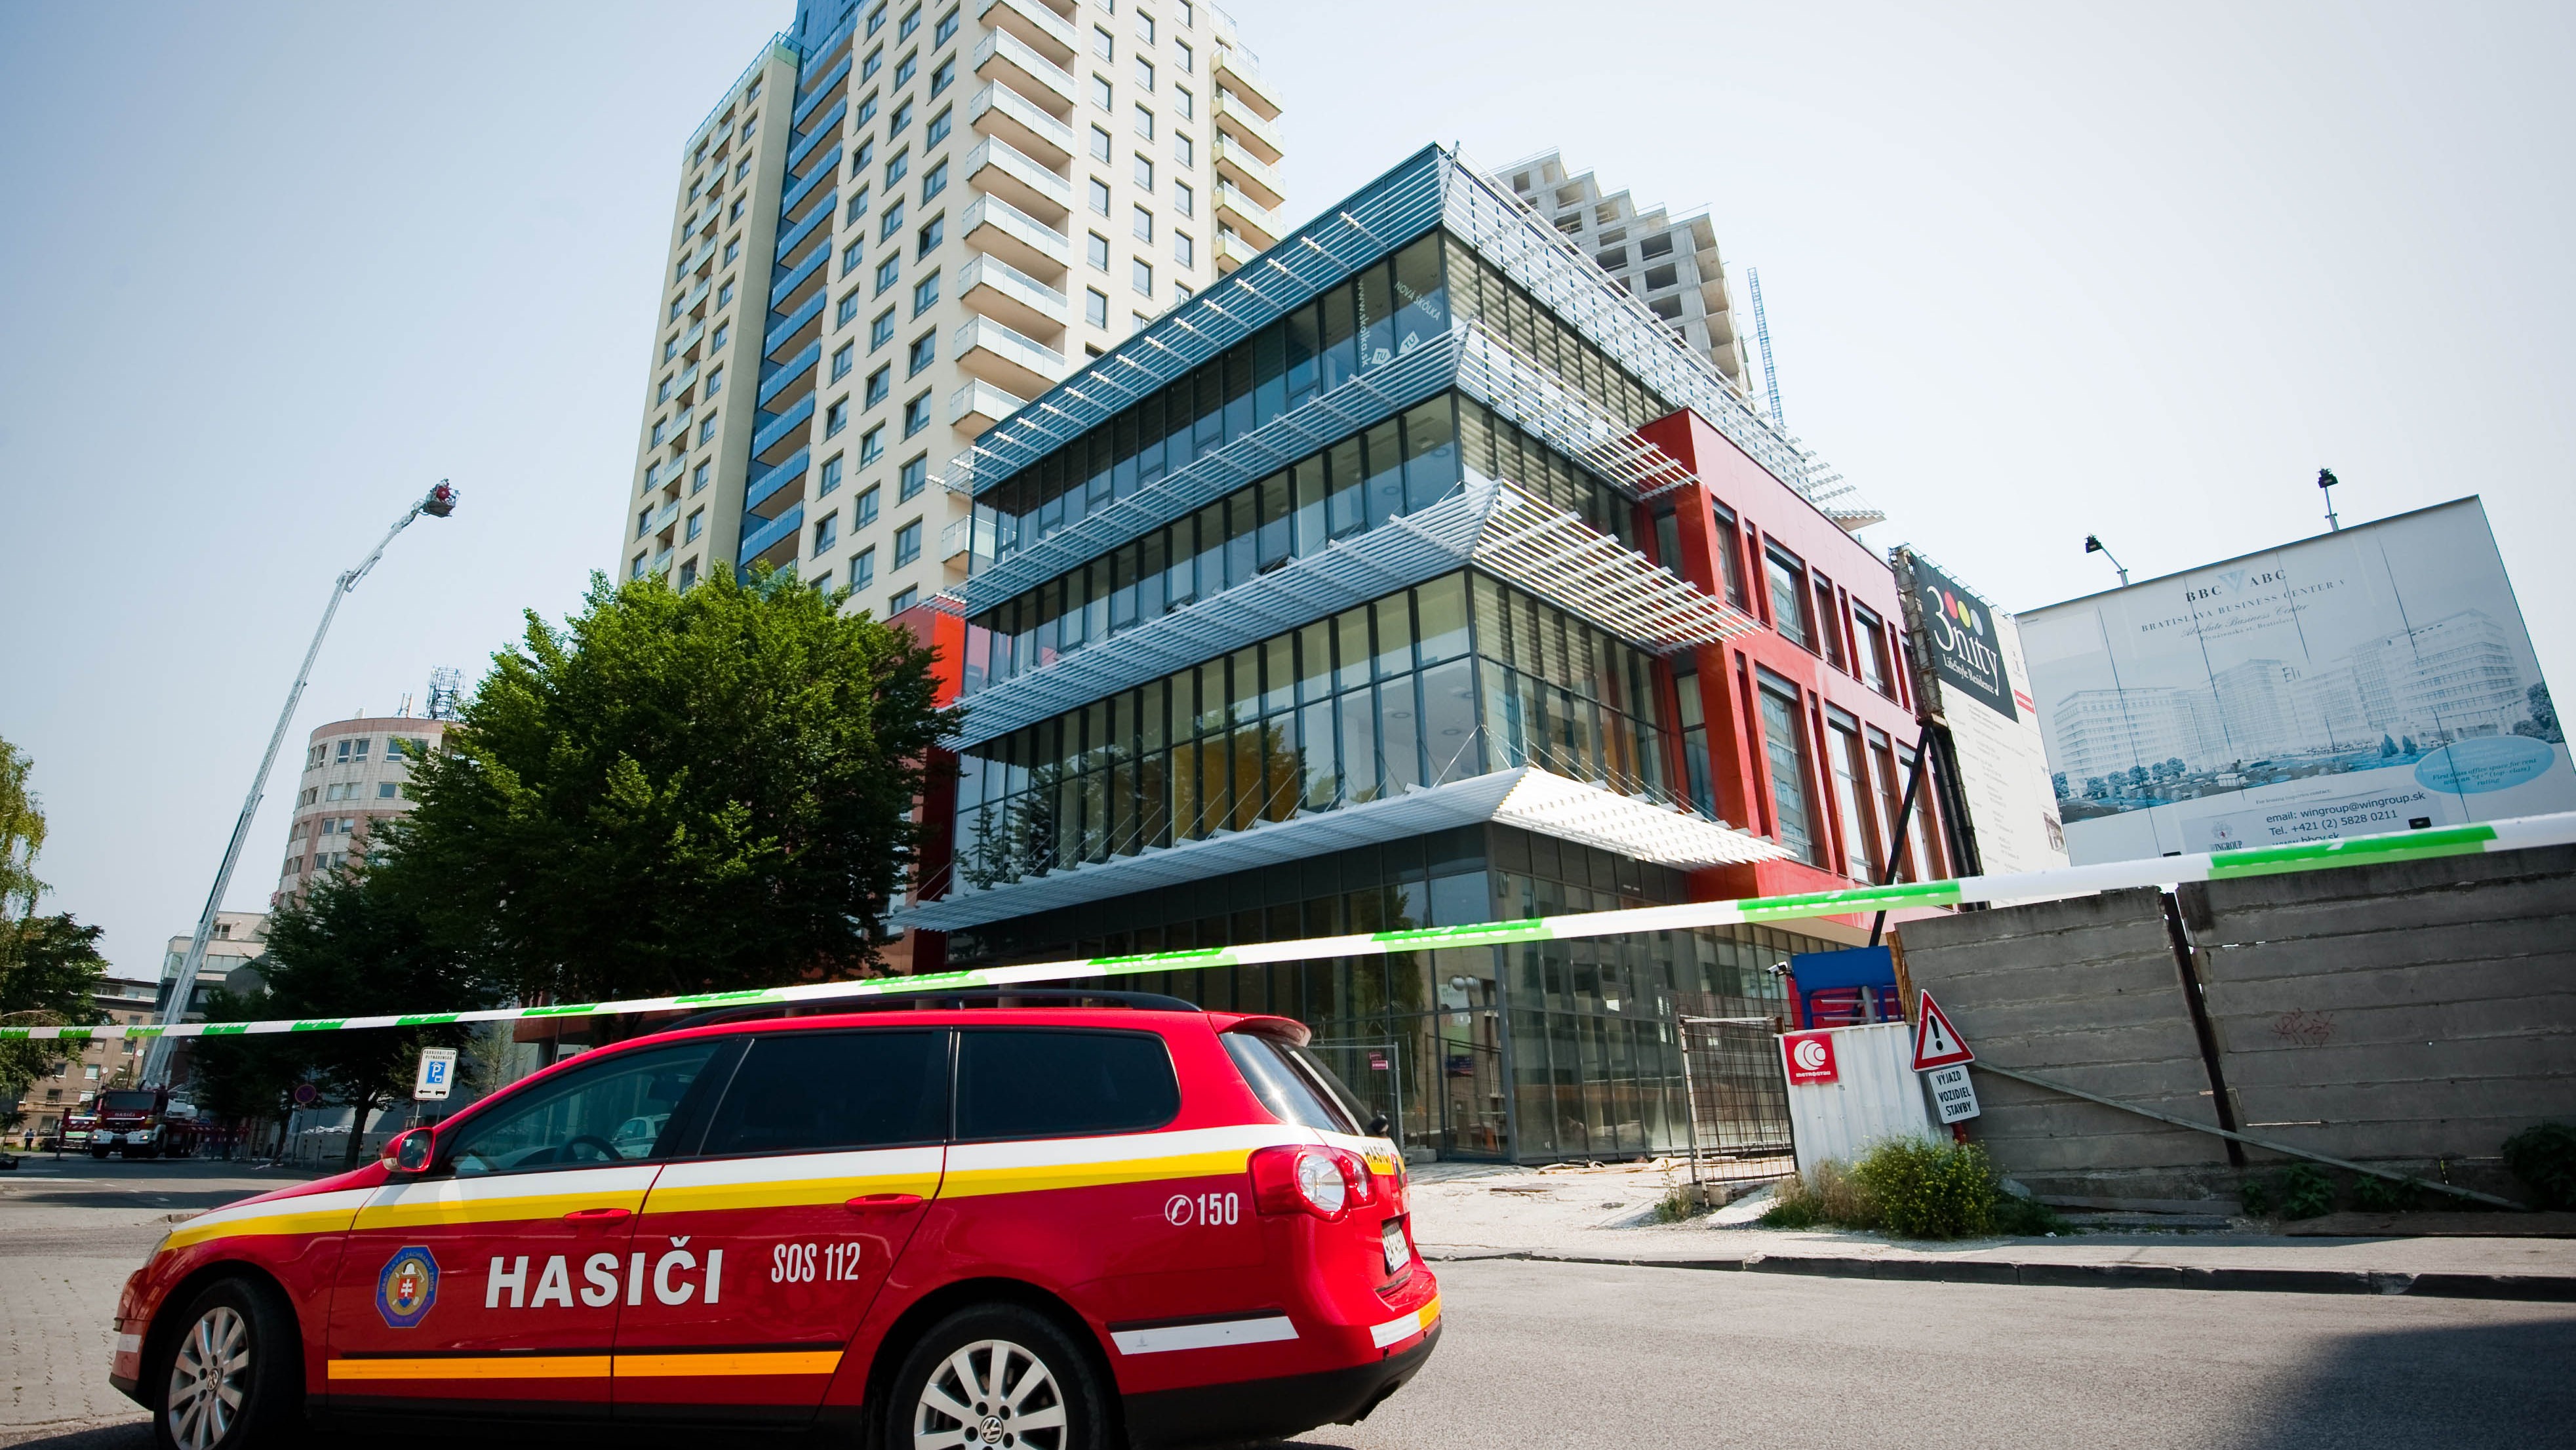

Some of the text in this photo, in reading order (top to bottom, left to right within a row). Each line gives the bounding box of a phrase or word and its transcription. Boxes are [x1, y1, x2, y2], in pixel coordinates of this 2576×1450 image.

[1395, 281, 1440, 321] NOVÁ ŠKÔLKA
[1358, 279, 1372, 367] www.skolka.sk
[2185, 569, 2287, 602] BBC ABC
[2141, 610, 2213, 632] BRATISLAVA
[2218, 595, 2277, 614] BUSINESS
[2284, 581, 2333, 598] CENTER
[2225, 613, 2270, 628] Business
[2276, 604, 2309, 616] Center
[2267, 791, 2426, 823] email: wingroup@wingroup.sk
[2269, 809, 2398, 836] Tel. +421 (2) 5828 0211
[1938, 1086, 1971, 1102] VOZIDIEL
[1946, 1100, 1972, 1116] STAVBY
[1197, 1192, 1238, 1226] 150
[485, 1236, 724, 1308] HASIČI
[771, 1242, 860, 1283] SOS 112
